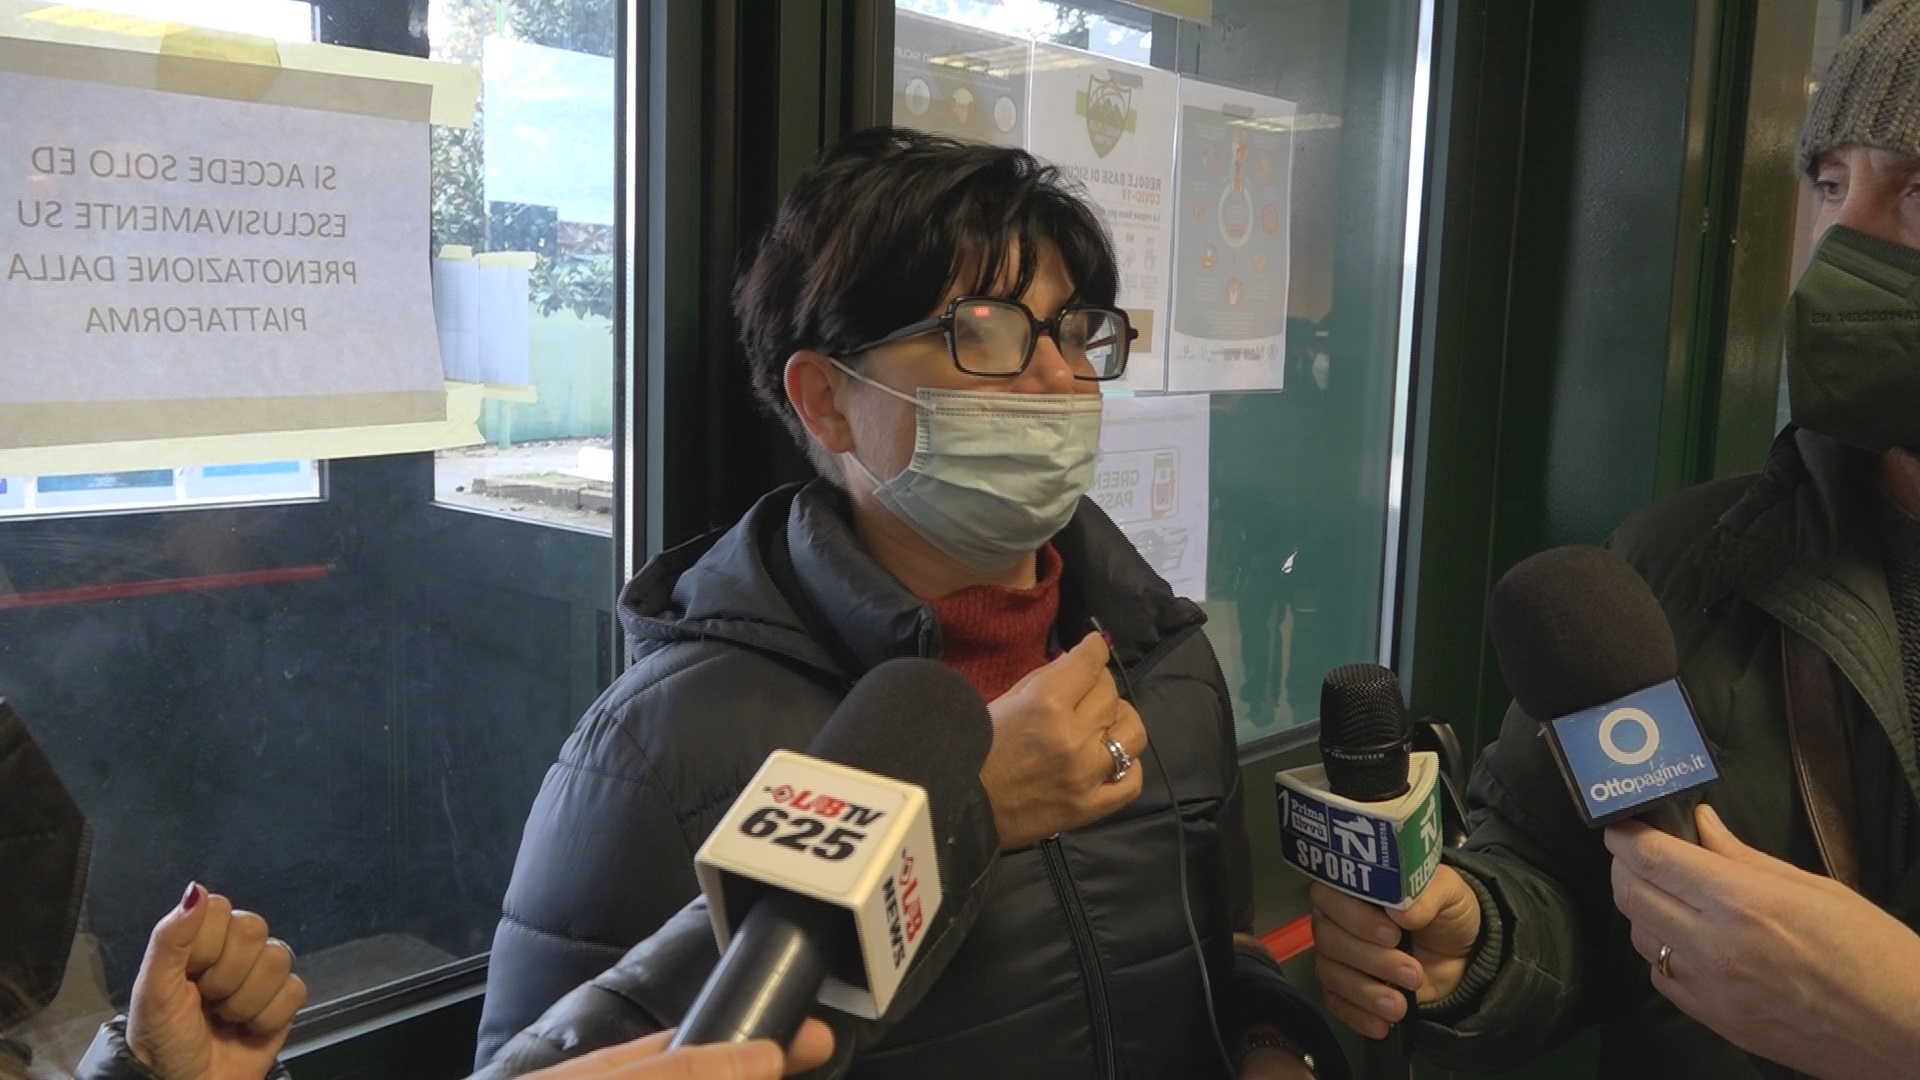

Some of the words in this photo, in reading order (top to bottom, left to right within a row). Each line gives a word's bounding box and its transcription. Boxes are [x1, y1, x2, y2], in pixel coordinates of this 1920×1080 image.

[738, 806, 867, 863] 625
[1296, 838, 1373, 893] SPORT
[882, 874, 906, 971] NEWS
